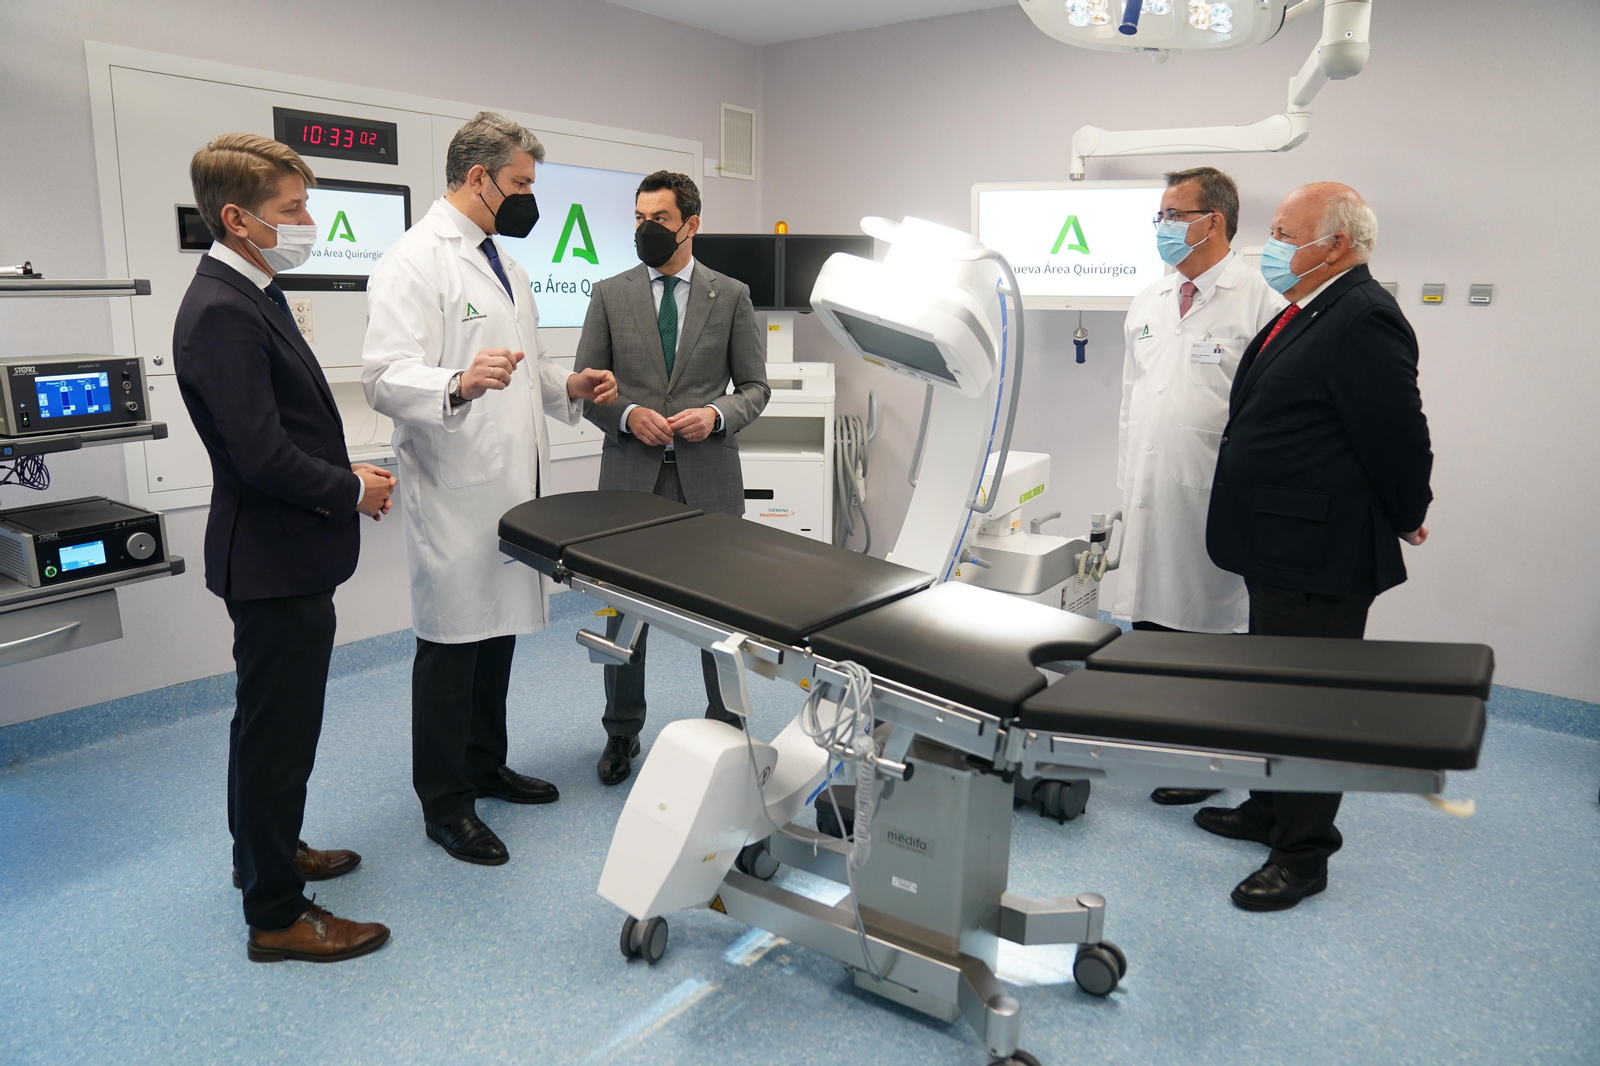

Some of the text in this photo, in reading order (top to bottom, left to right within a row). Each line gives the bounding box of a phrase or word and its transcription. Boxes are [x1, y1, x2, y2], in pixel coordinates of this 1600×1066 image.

[303, 125, 377, 148] 10:33 02
[323, 247, 343, 258] Área
[345, 249, 383, 261] Quirúrgic
[1011, 261, 1136, 277] ueva Área Quirúrgica
[545, 273, 576, 293] Área
[14, 366, 36, 374] STORZ
[38, 532, 59, 541] STORZ
[887, 830, 927, 851] medifa
